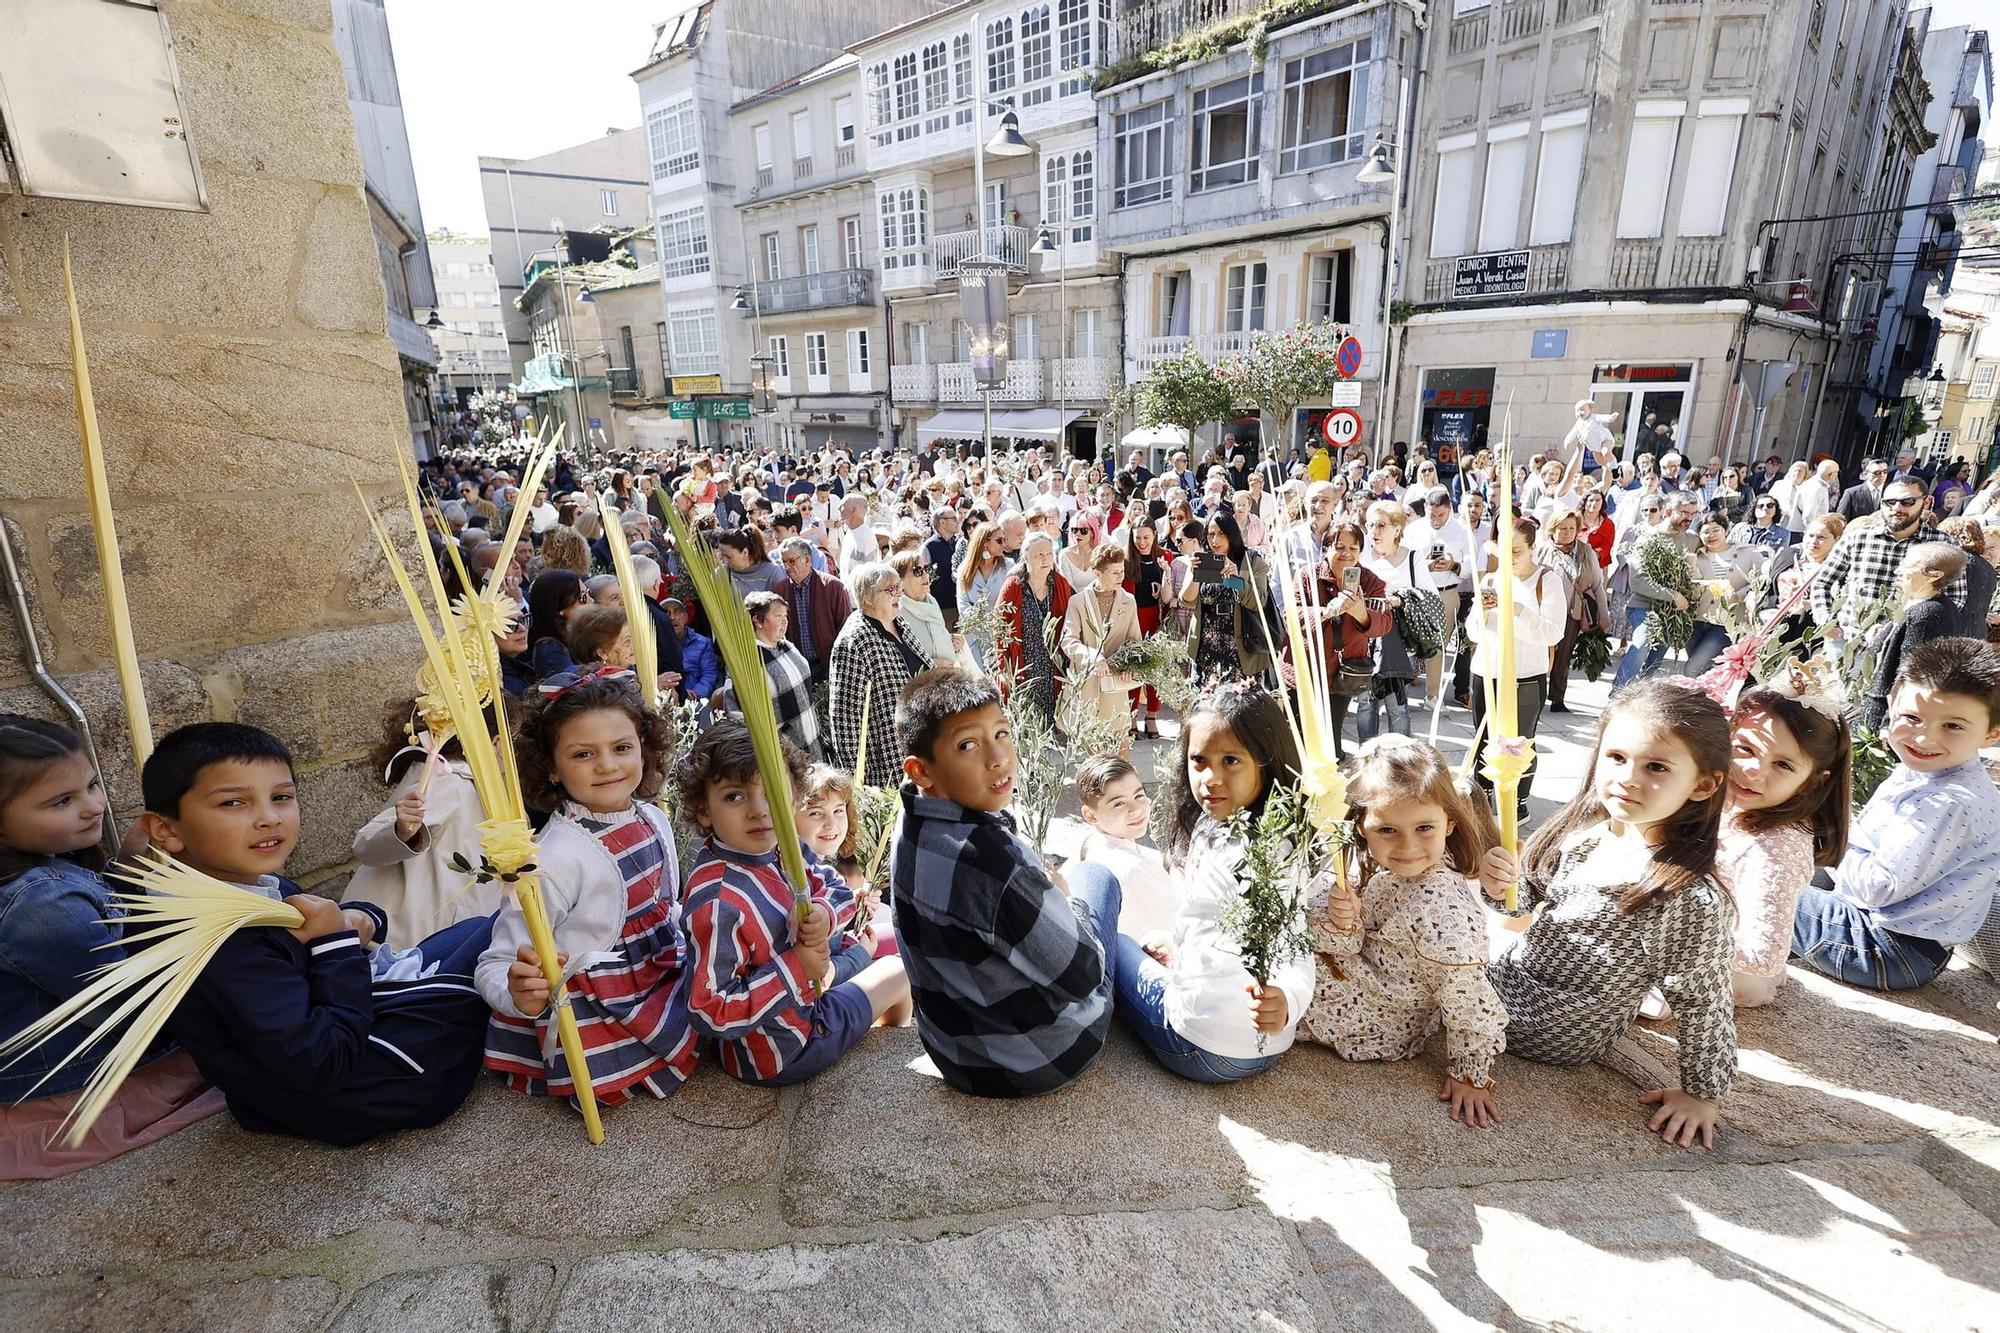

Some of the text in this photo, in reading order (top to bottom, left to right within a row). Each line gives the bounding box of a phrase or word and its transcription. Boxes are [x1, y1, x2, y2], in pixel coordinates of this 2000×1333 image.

[1458, 254, 1528, 272] CLINICA DENTAL
[1457, 274, 1473, 285] Juan
[1484, 270, 1504, 282] Verdú
[1506, 269, 1526, 280] Casal
[1484, 282, 1524, 292] ODONTOLOGO
[1435, 388, 1489, 406] FLEX
[713, 402, 721, 416] EL
[1333, 420, 1352, 434] 10
